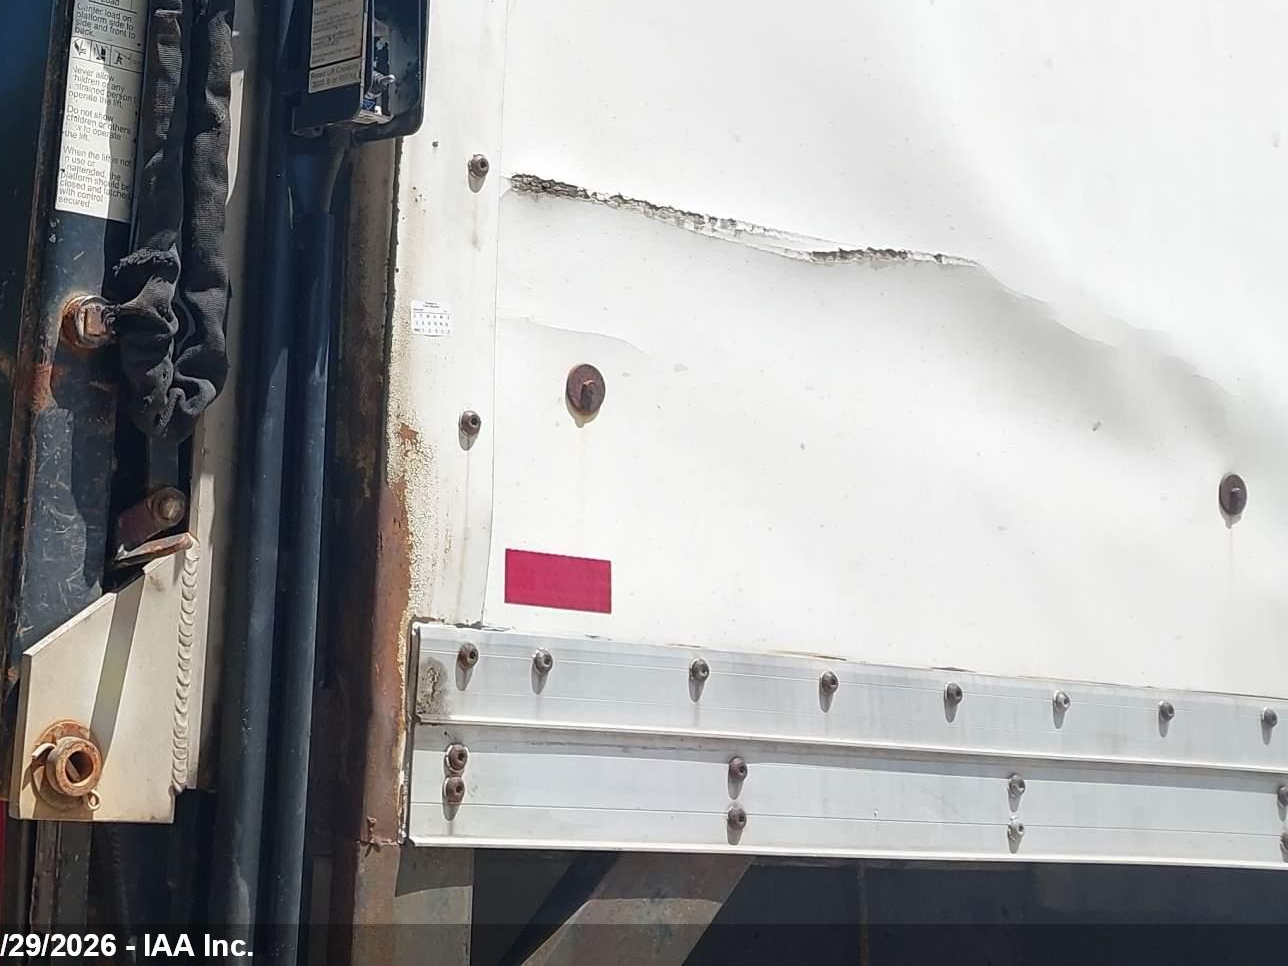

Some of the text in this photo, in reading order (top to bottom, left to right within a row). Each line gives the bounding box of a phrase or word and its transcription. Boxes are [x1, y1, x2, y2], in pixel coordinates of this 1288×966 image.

[77, 2, 103, 15] Center
[104, 8, 121, 19] load
[75, 18, 136, 40] side and front to
[76, 11, 134, 31] platform side to
[72, 74, 100, 87] hildren
[111, 84, 125, 94] any
[95, 72, 115, 82] allow
[66, 104, 114, 122] Do not show
[66, 114, 97, 127] children
[64, 130, 78, 139] the
[63, 145, 87, 156] When
[87, 150, 100, 161] the
[71, 157, 86, 165] use
[60, 172, 93, 184] platform
[62, 164, 107, 180] nattended,
[59, 179, 129, 200] closed and latche
[59, 187, 103, 203] with control
